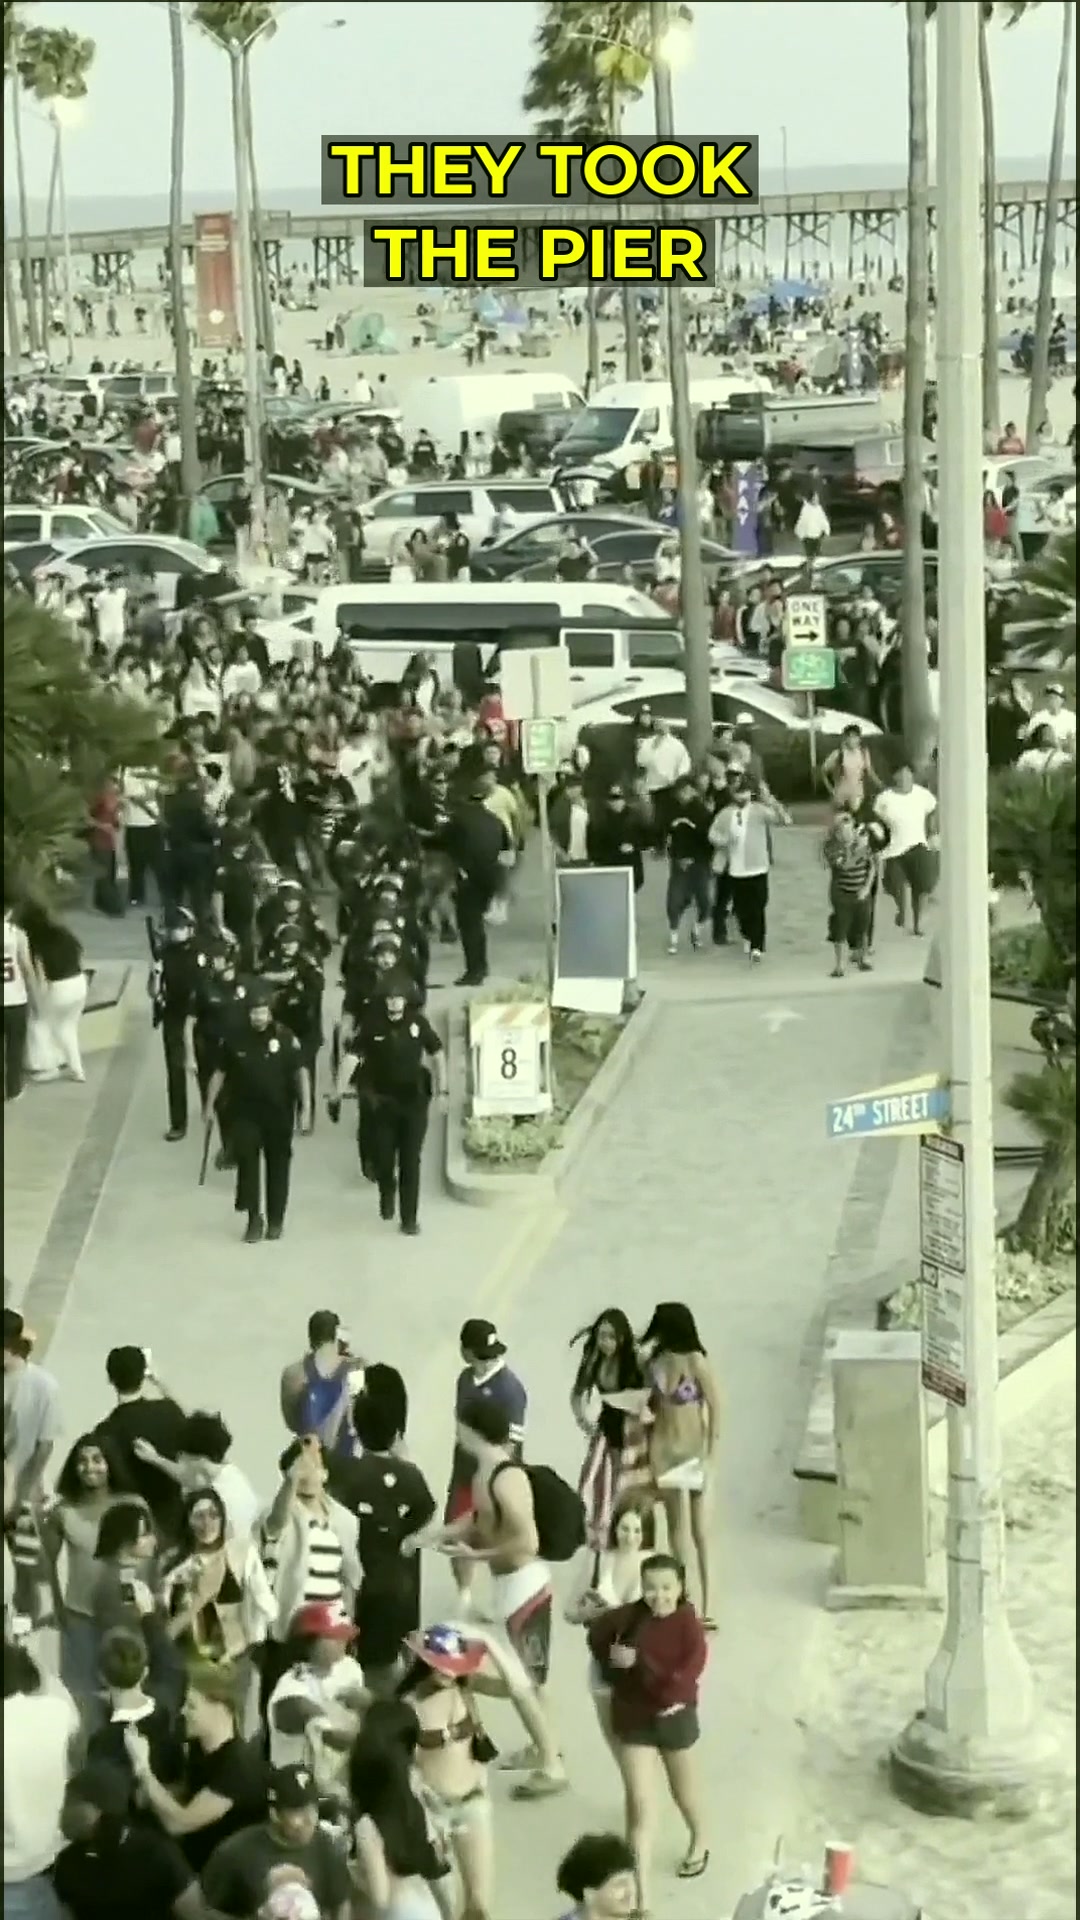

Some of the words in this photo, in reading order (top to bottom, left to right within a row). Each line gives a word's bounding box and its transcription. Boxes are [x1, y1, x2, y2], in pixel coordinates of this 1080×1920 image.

[791, 601, 820, 613] ONE
[792, 614, 821, 626] WAY
[501, 1047, 518, 1081] 8
[872, 1092, 929, 1126] STREET
